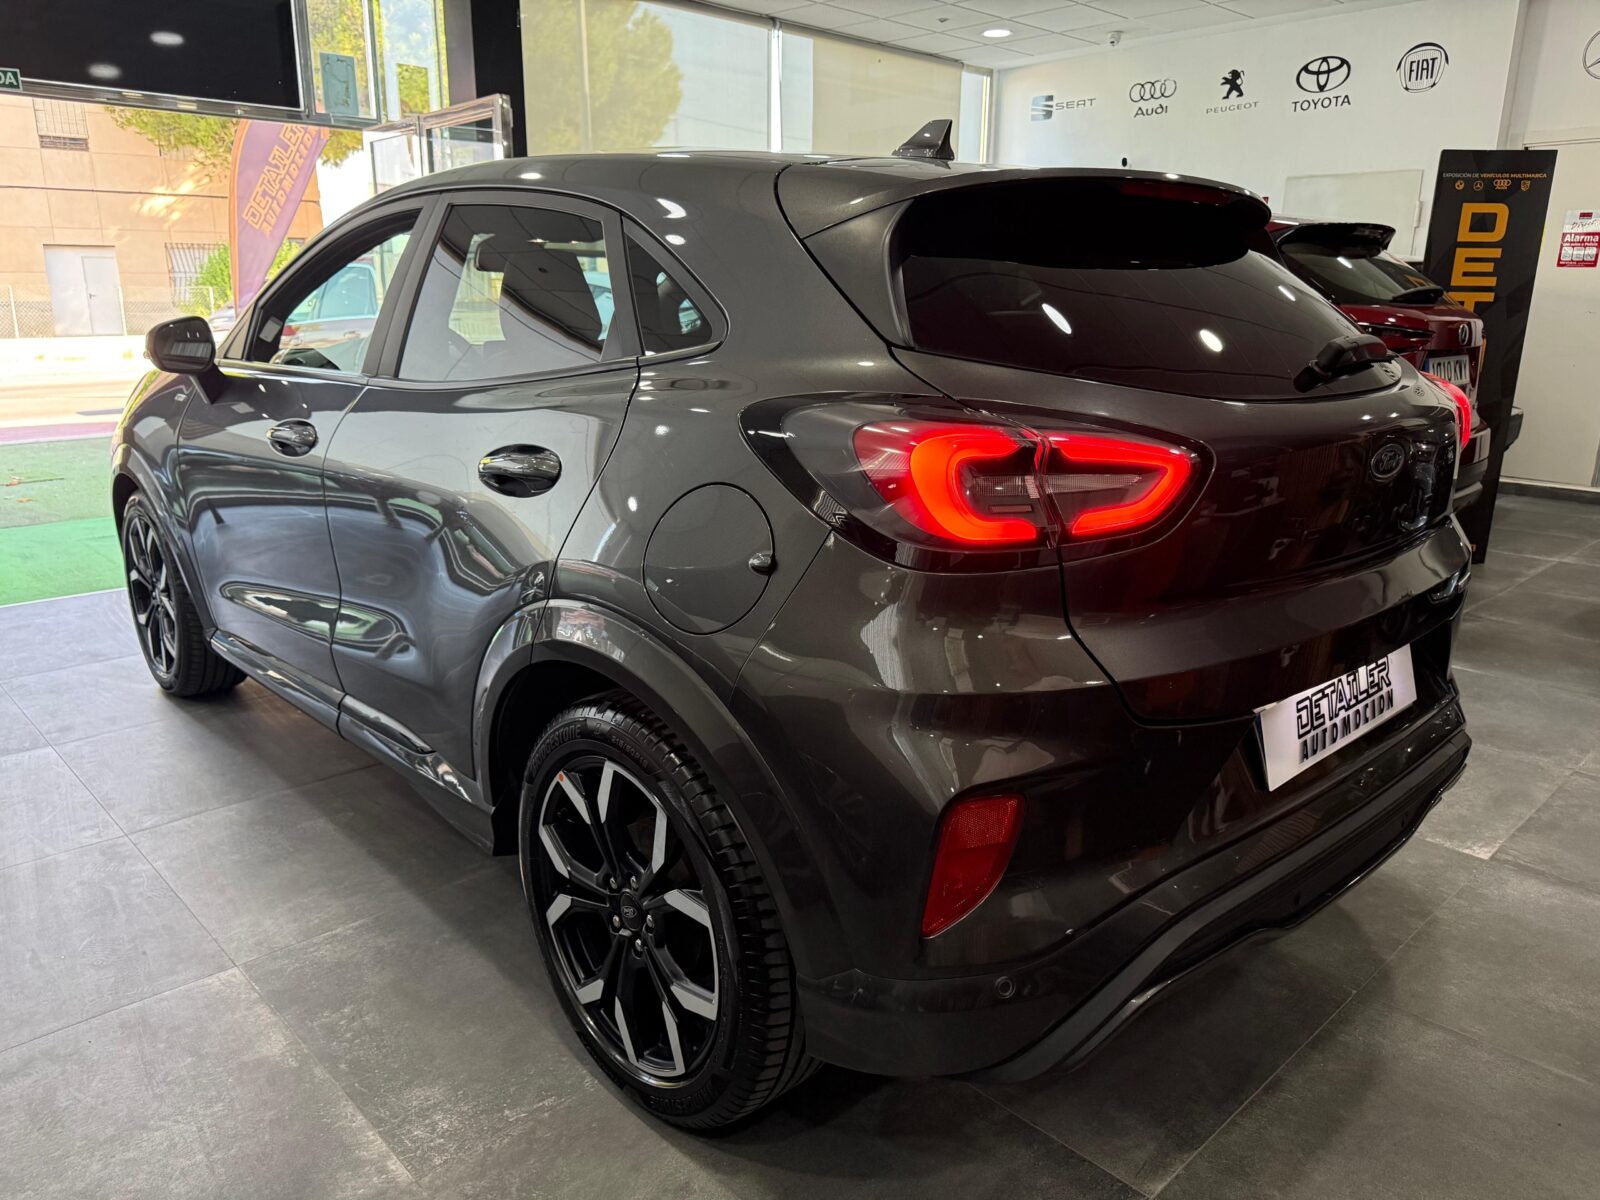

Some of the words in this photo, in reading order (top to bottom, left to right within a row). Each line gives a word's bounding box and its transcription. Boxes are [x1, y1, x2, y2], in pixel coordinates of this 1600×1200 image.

[1408, 57, 1438, 82] FIAT
[1055, 98, 1097, 111] SEAT
[1133, 104, 1169, 118] Audi
[1205, 101, 1260, 115] PEUGEOT
[1291, 94, 1352, 113] TOYOTA
[1563, 233, 1599, 243] Alarma
[1296, 655, 1392, 740] DETAILER
[1299, 688, 1394, 763] AUTOMOCION
